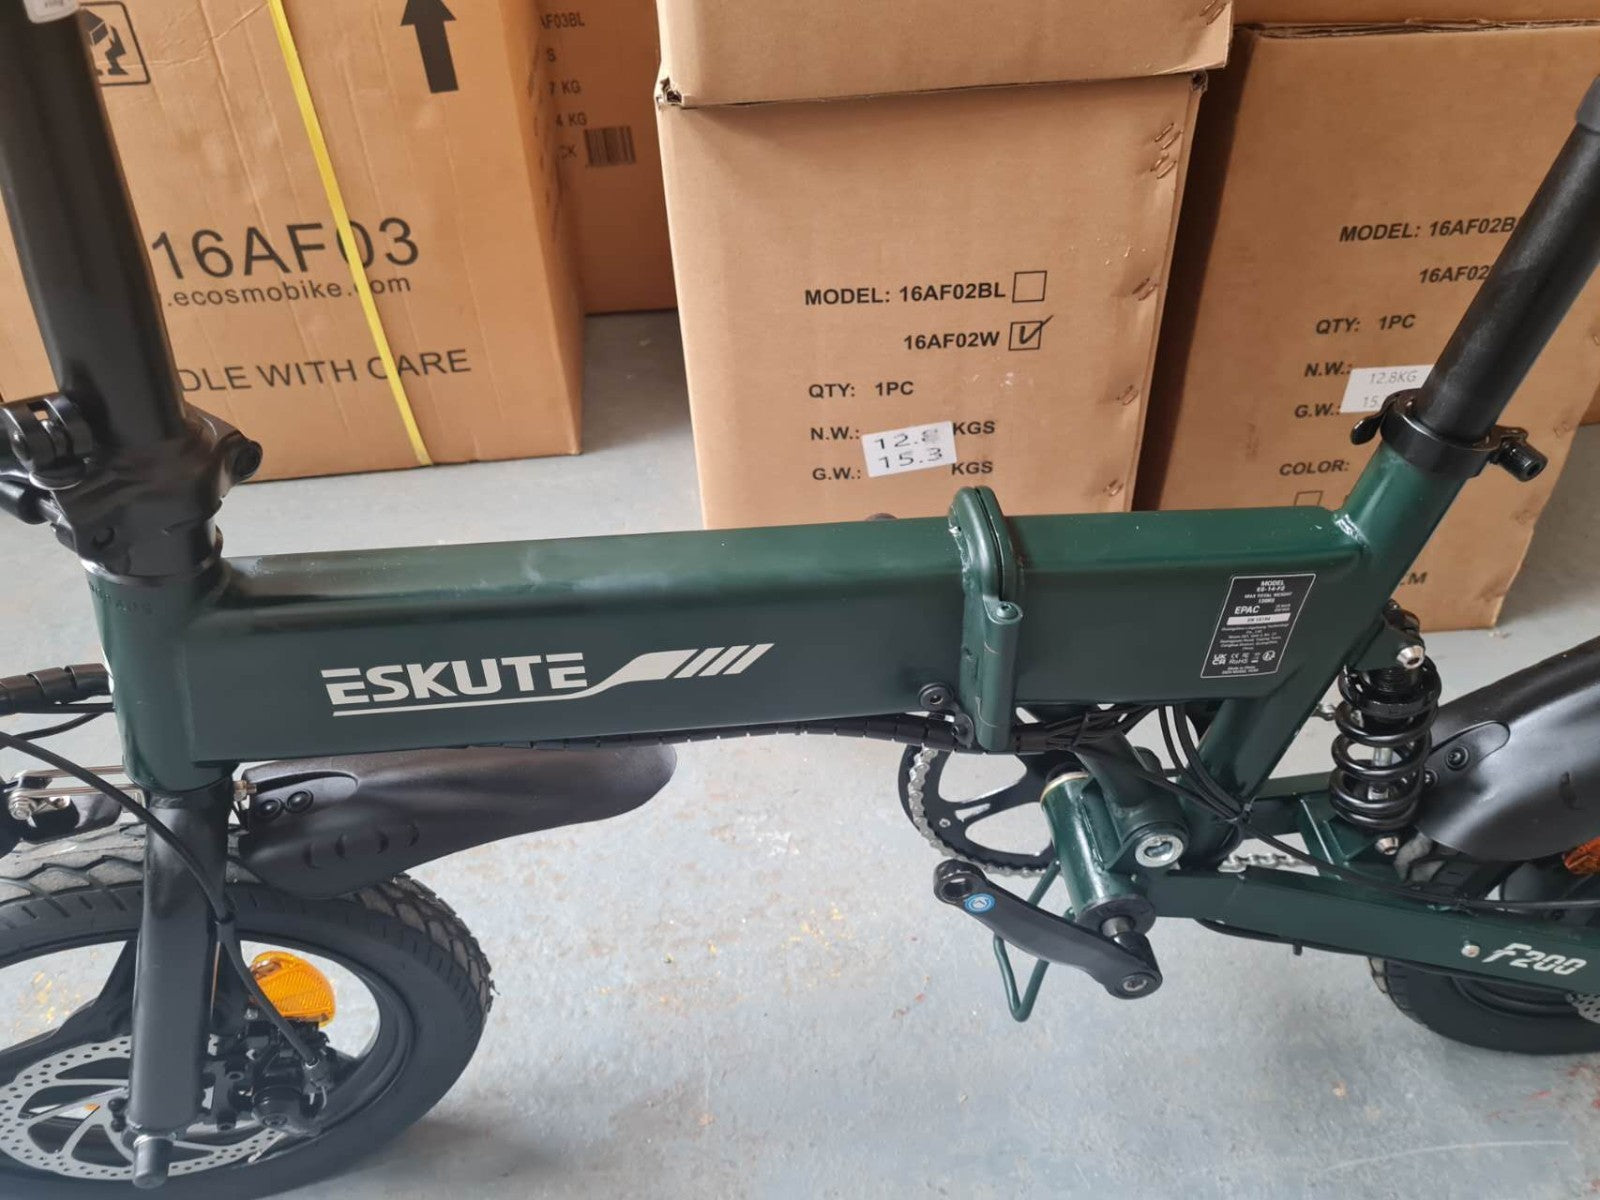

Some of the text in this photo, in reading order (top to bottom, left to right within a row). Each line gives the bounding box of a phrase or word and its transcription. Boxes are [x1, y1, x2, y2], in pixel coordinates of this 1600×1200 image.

[562, 80, 581, 94] KG
[568, 112, 587, 126] KG
[1339, 216, 1517, 242] MODEL: 16AF02B
[152, 217, 419, 280] 16AF03
[1419, 265, 1491, 284] 16AF02
[166, 276, 411, 307] .ecosmobike.om
[804, 282, 1006, 305] MODEL: 16AF02BL
[1316, 314, 1416, 334] QTY: 1PC
[904, 331, 1000, 350] 16AF02W
[177, 349, 472, 392] DLE WITH CARE
[1305, 361, 1352, 377] N.W.:
[808, 381, 914, 398] QTY: 1PC
[1294, 402, 1341, 418] G.W.:
[811, 421, 996, 440] N.W.: KGS
[879, 447, 942, 469] 15.3
[1280, 459, 1350, 476] COLOR:
[812, 461, 994, 481] G.W.: KGS
[1234, 605, 1260, 615] EPAC
[320, 652, 588, 705] ESKUTE
[1482, 942, 1587, 975] F200
